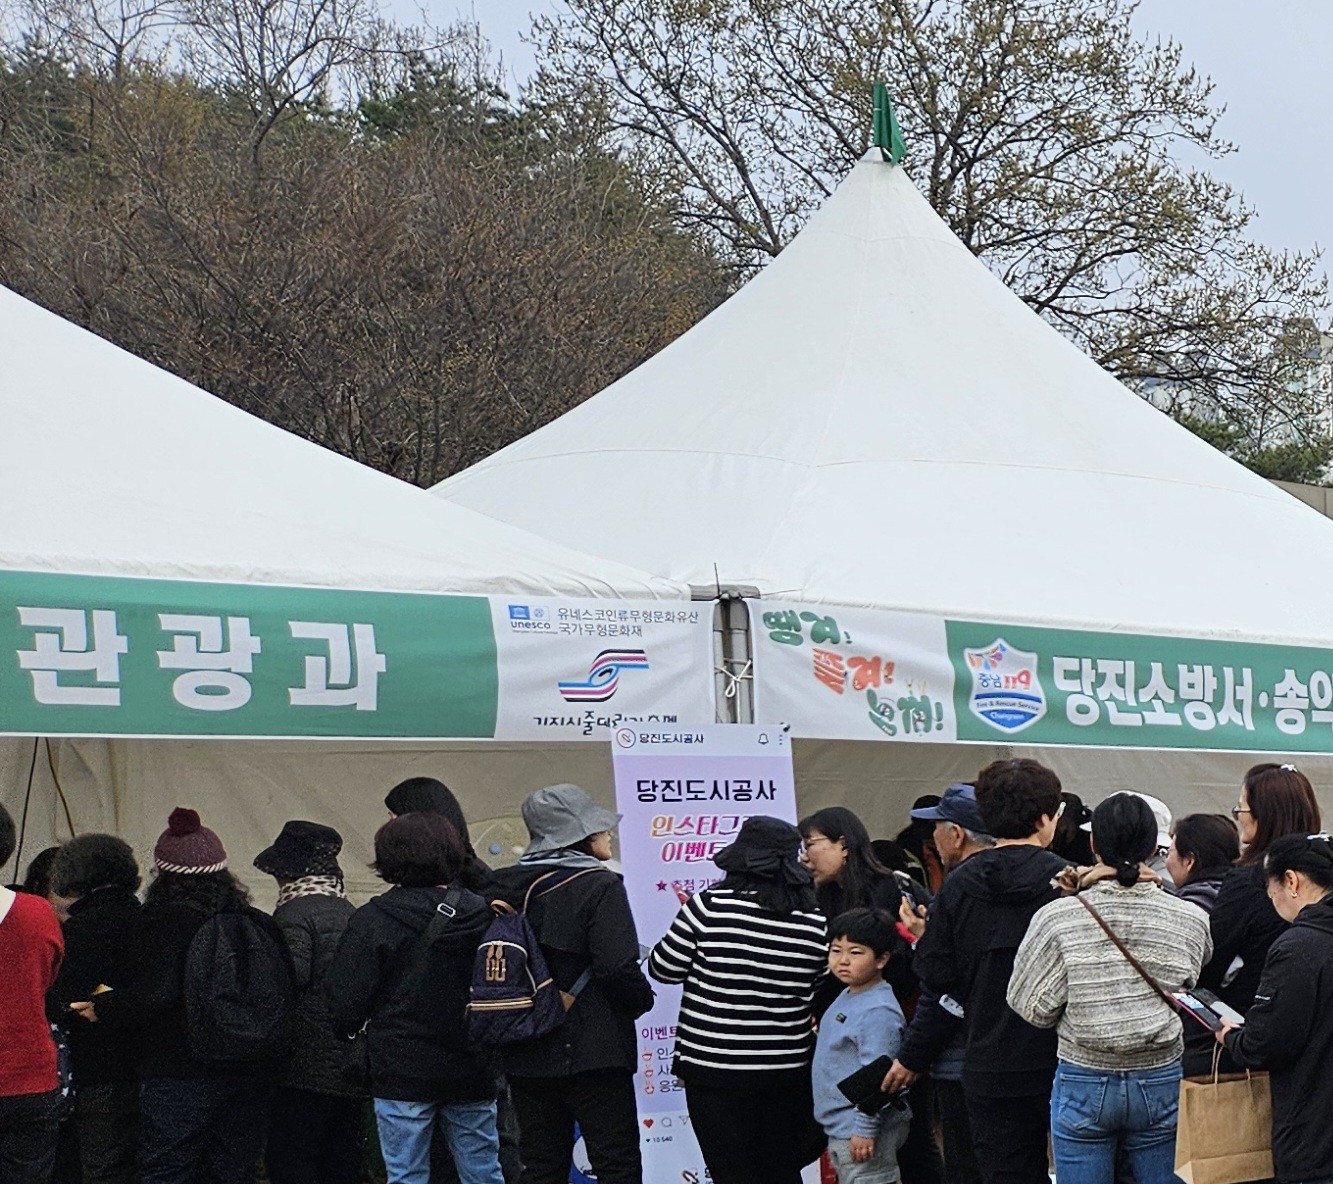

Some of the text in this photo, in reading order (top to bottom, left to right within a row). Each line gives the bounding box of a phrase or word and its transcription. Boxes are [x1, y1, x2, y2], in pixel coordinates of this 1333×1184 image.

[510, 621, 550, 629] unesco
[558, 623, 643, 637] 국가무형문화재
[16, 606, 386, 712] 관광과
[639, 733, 704, 744] 당진도시공사
[637, 780, 776, 802] 당진도시공사
[652, 816, 749, 837] 인스타그
